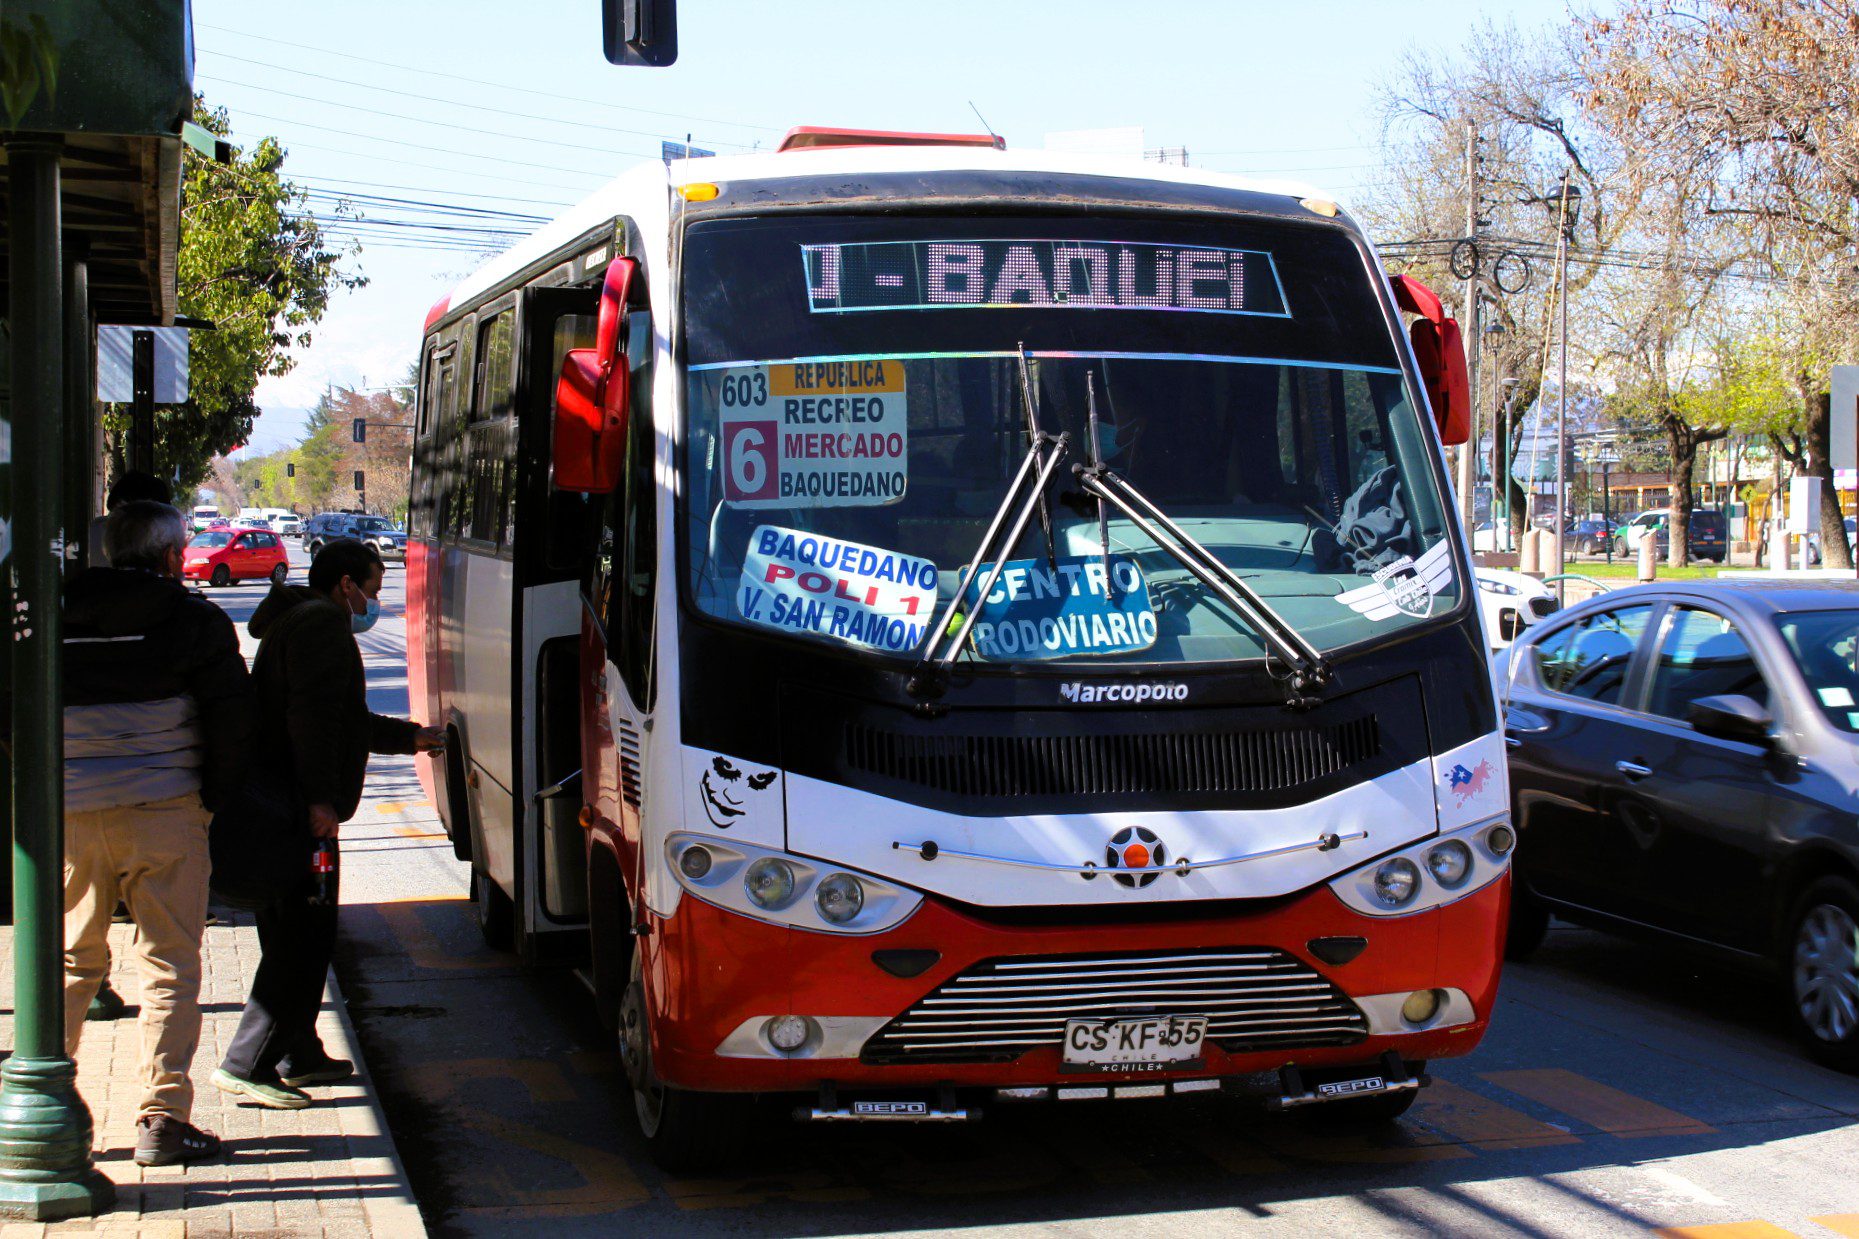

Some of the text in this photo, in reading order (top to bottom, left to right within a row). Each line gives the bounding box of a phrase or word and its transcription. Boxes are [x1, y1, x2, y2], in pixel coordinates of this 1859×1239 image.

[795, 362, 886, 388] REPUBLICA
[722, 372, 767, 407] 603
[784, 397, 885, 425] RECREO
[784, 432, 903, 459] MERCADO
[730, 427, 767, 494] 6
[780, 471, 905, 497] BAQUEDANO
[757, 529, 938, 590] BAQUEDANO
[764, 563, 920, 616] POLI 1
[977, 561, 1141, 604] CENTRO
[744, 586, 926, 650] V. SAN RAMON
[976, 610, 1157, 656] RODOVIARIO
[1060, 682, 1190, 703] Marcopolo
[1111, 1053, 1158, 1062] CHILE
[1111, 1063, 1155, 1072] CHILE
[857, 1103, 924, 1112] BEPO
